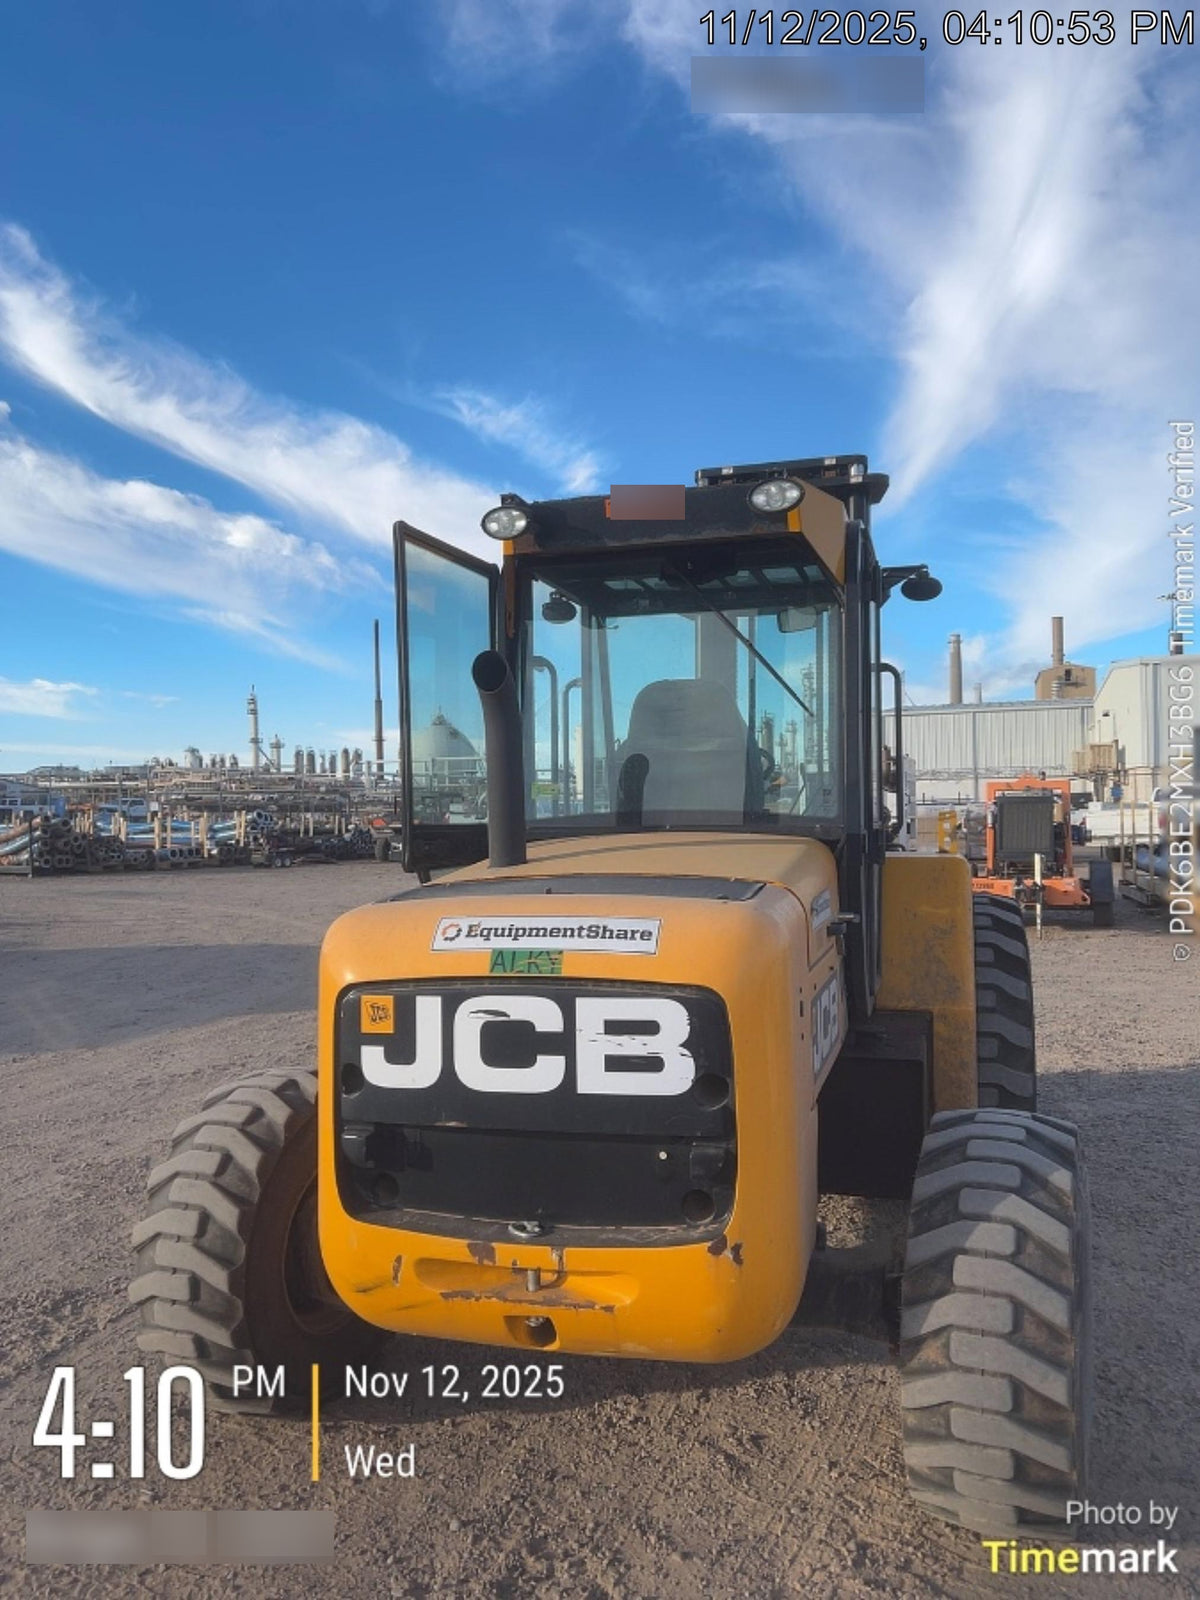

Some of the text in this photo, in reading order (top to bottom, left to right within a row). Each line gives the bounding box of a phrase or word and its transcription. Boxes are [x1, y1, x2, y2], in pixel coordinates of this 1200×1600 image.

[464, 920, 654, 943] EquipmentShare
[360, 995, 696, 1097] JCB
[813, 978, 839, 1074] JCB
